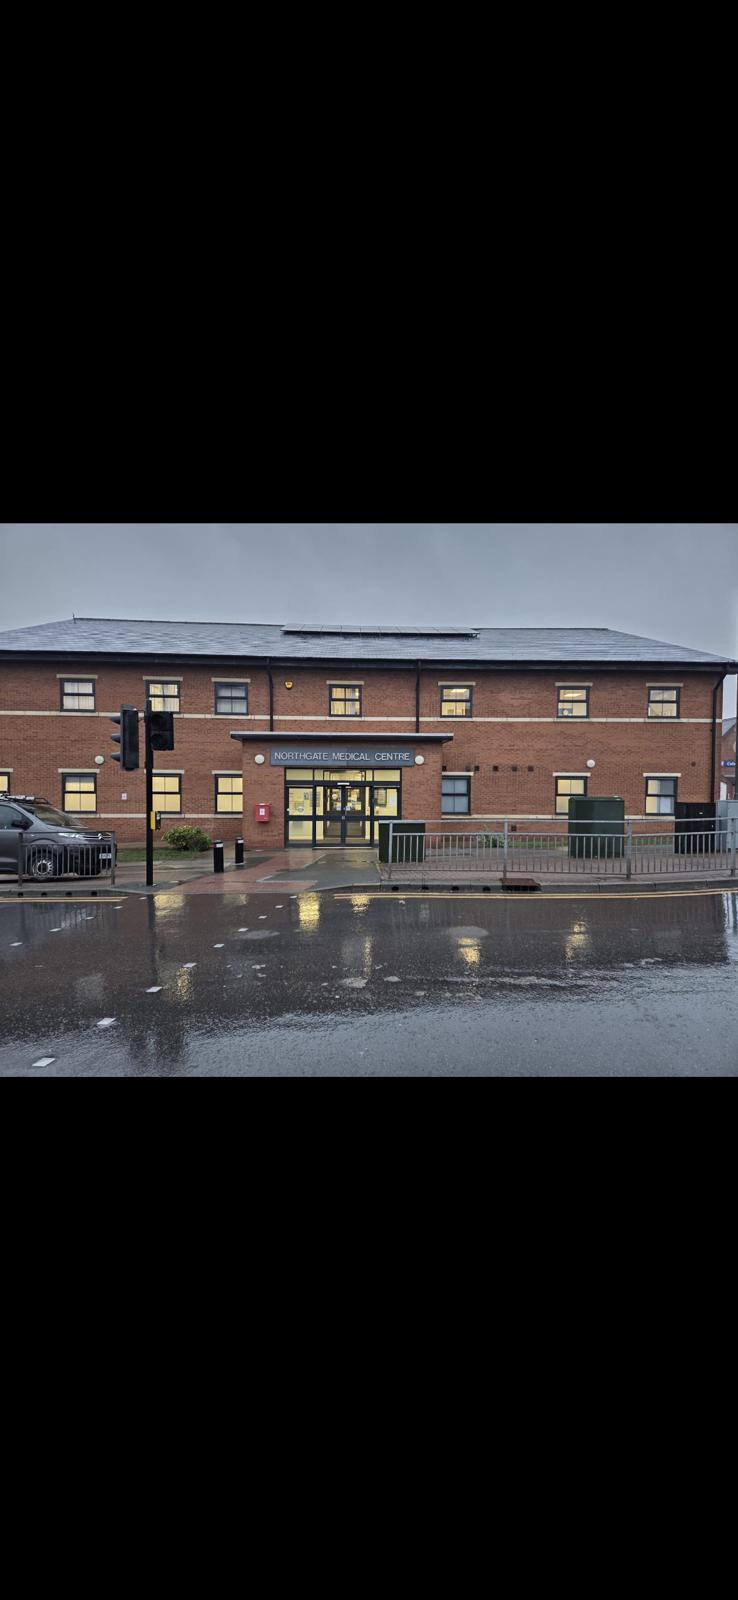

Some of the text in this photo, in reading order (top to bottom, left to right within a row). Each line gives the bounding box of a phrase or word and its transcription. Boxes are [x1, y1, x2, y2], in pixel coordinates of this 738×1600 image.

[274, 751, 411, 761] NORTHGATE MEDICAL CENTRE
